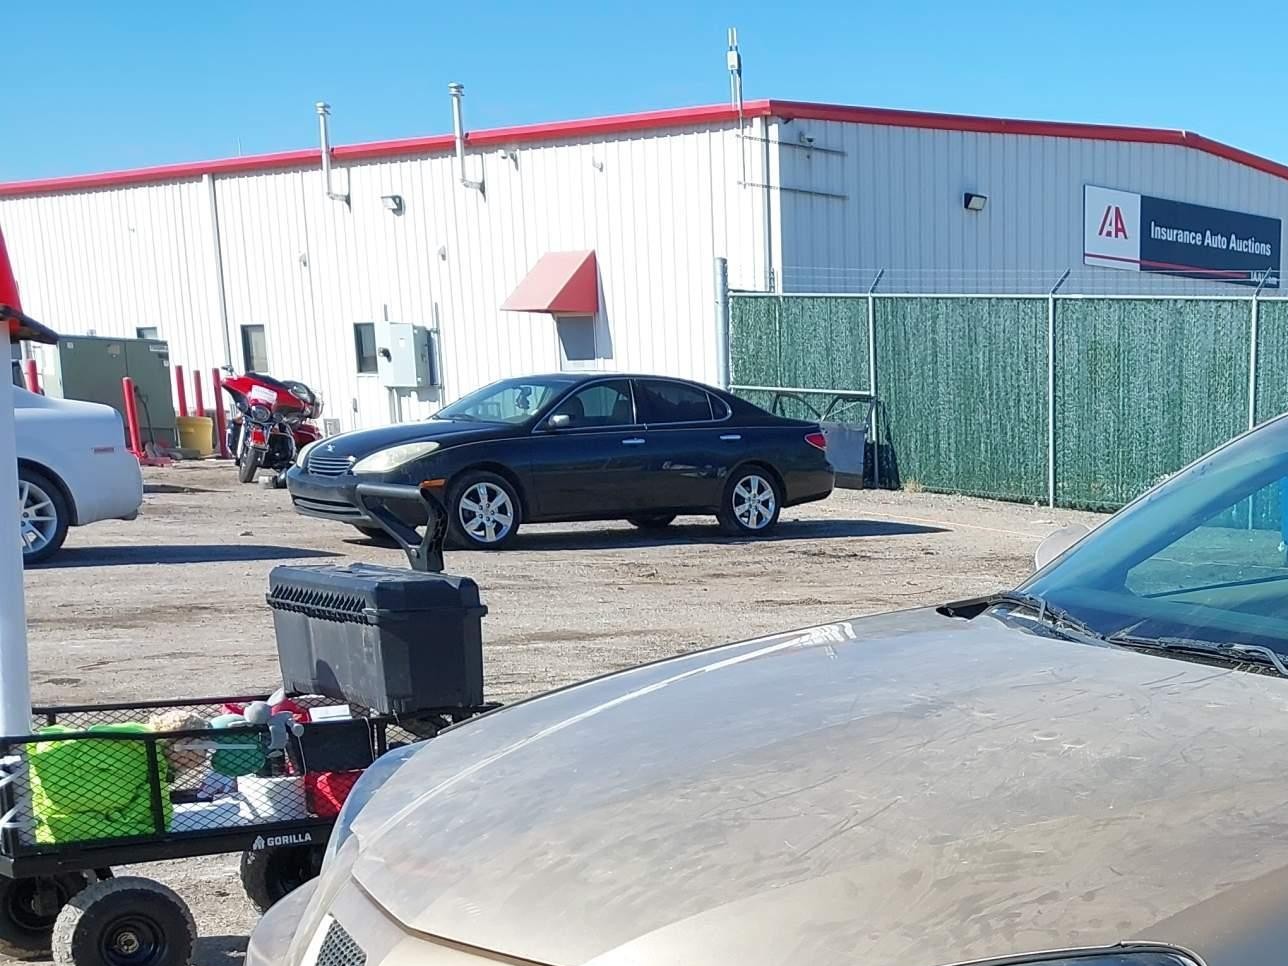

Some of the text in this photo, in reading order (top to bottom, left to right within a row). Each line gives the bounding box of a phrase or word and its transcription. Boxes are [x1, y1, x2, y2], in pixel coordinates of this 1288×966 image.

[1151, 220, 1272, 257] Insurance Auto Auctions
[266, 832, 312, 847] GORILLA
